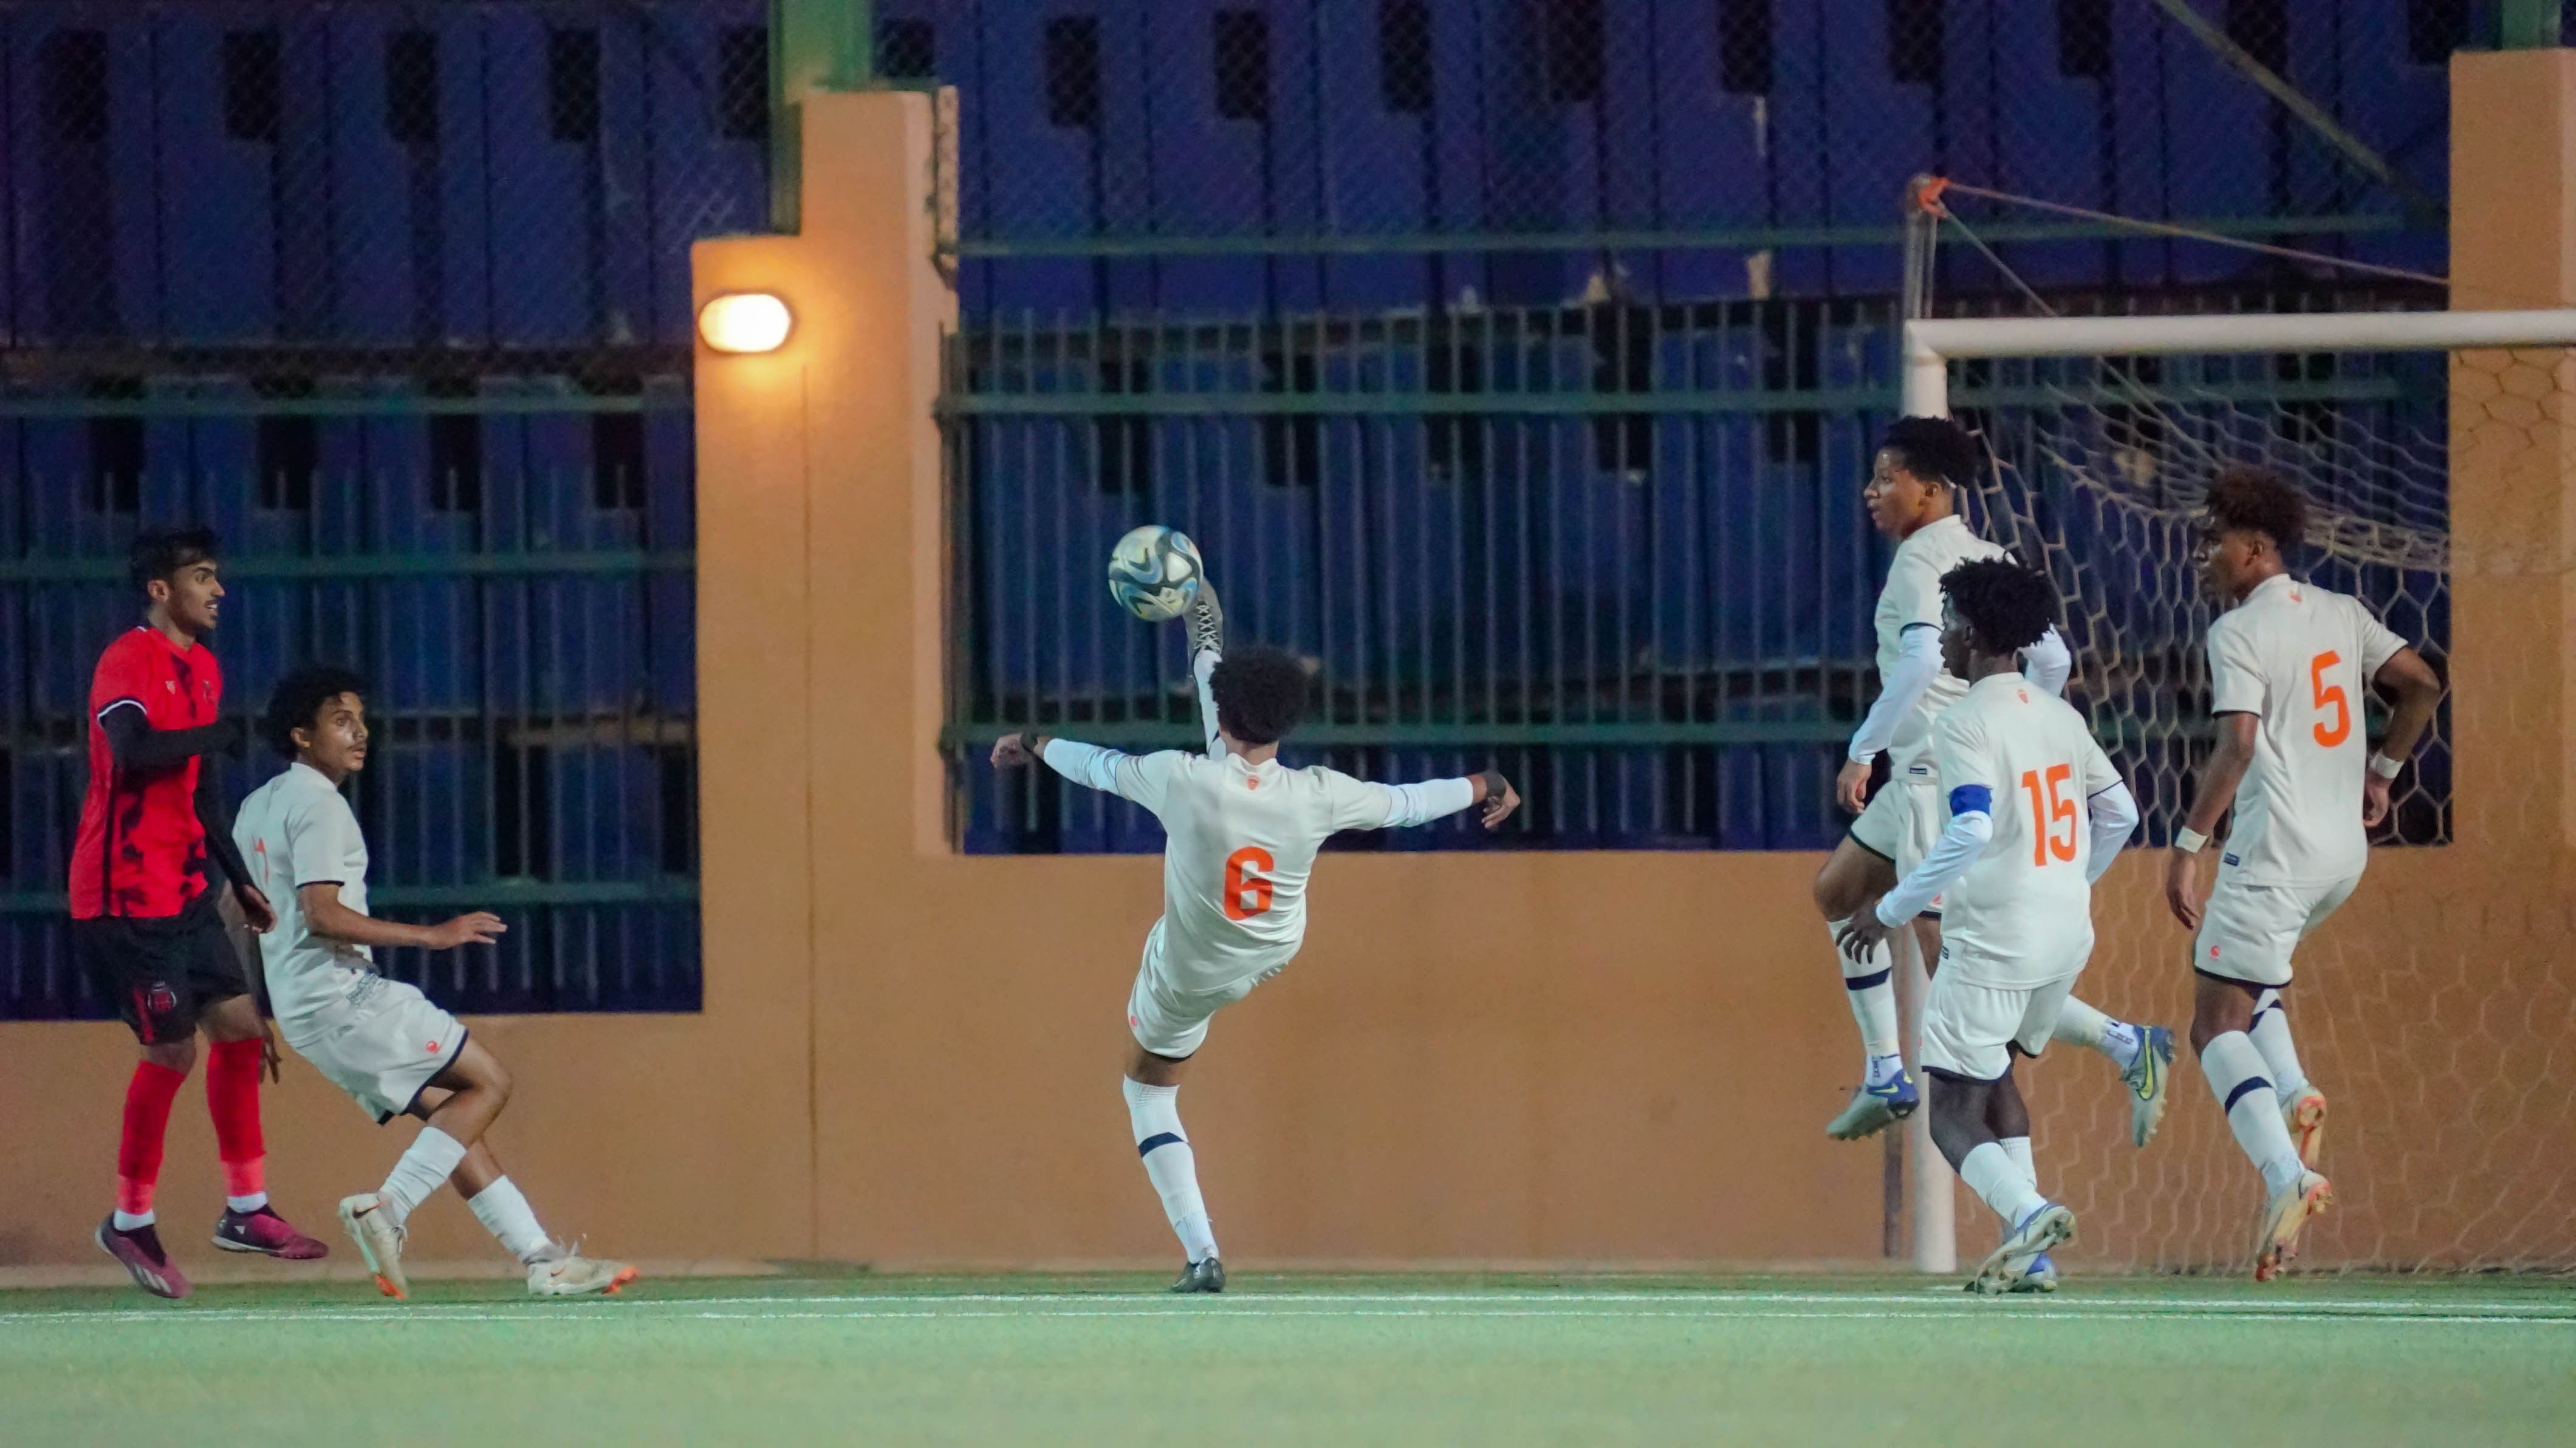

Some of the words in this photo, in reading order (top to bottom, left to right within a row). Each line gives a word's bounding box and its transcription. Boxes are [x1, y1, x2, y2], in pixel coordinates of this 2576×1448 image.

[2311, 651, 2351, 748] 5
[2022, 763, 2077, 867] 15
[1224, 846, 1274, 920] 6
